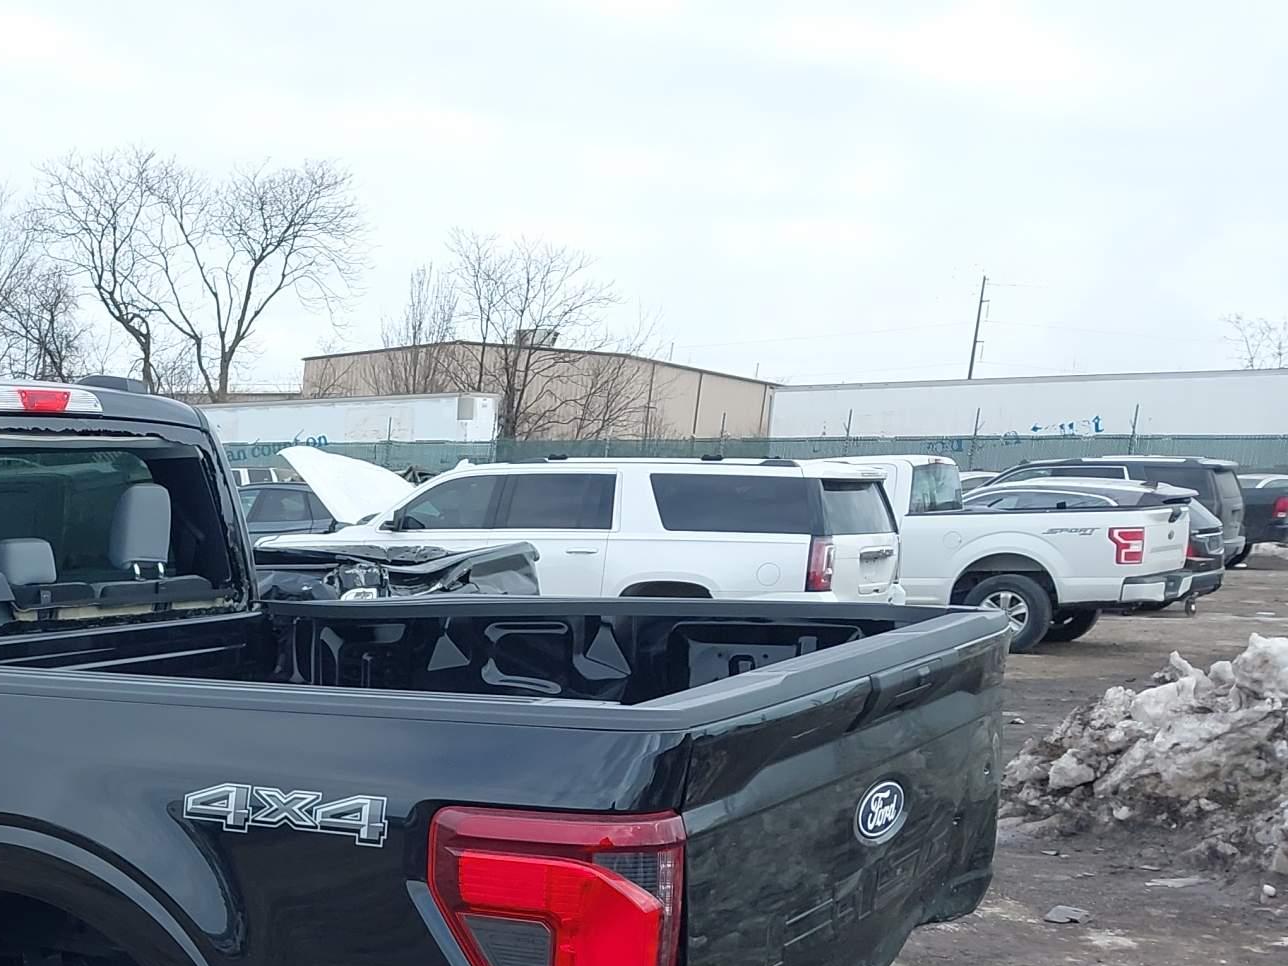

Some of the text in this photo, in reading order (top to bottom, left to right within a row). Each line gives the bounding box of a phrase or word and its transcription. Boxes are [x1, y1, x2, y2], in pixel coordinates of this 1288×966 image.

[306, 434, 328, 448] on
[1041, 527, 1100, 536] SPORT
[867, 789, 898, 831] Ford
